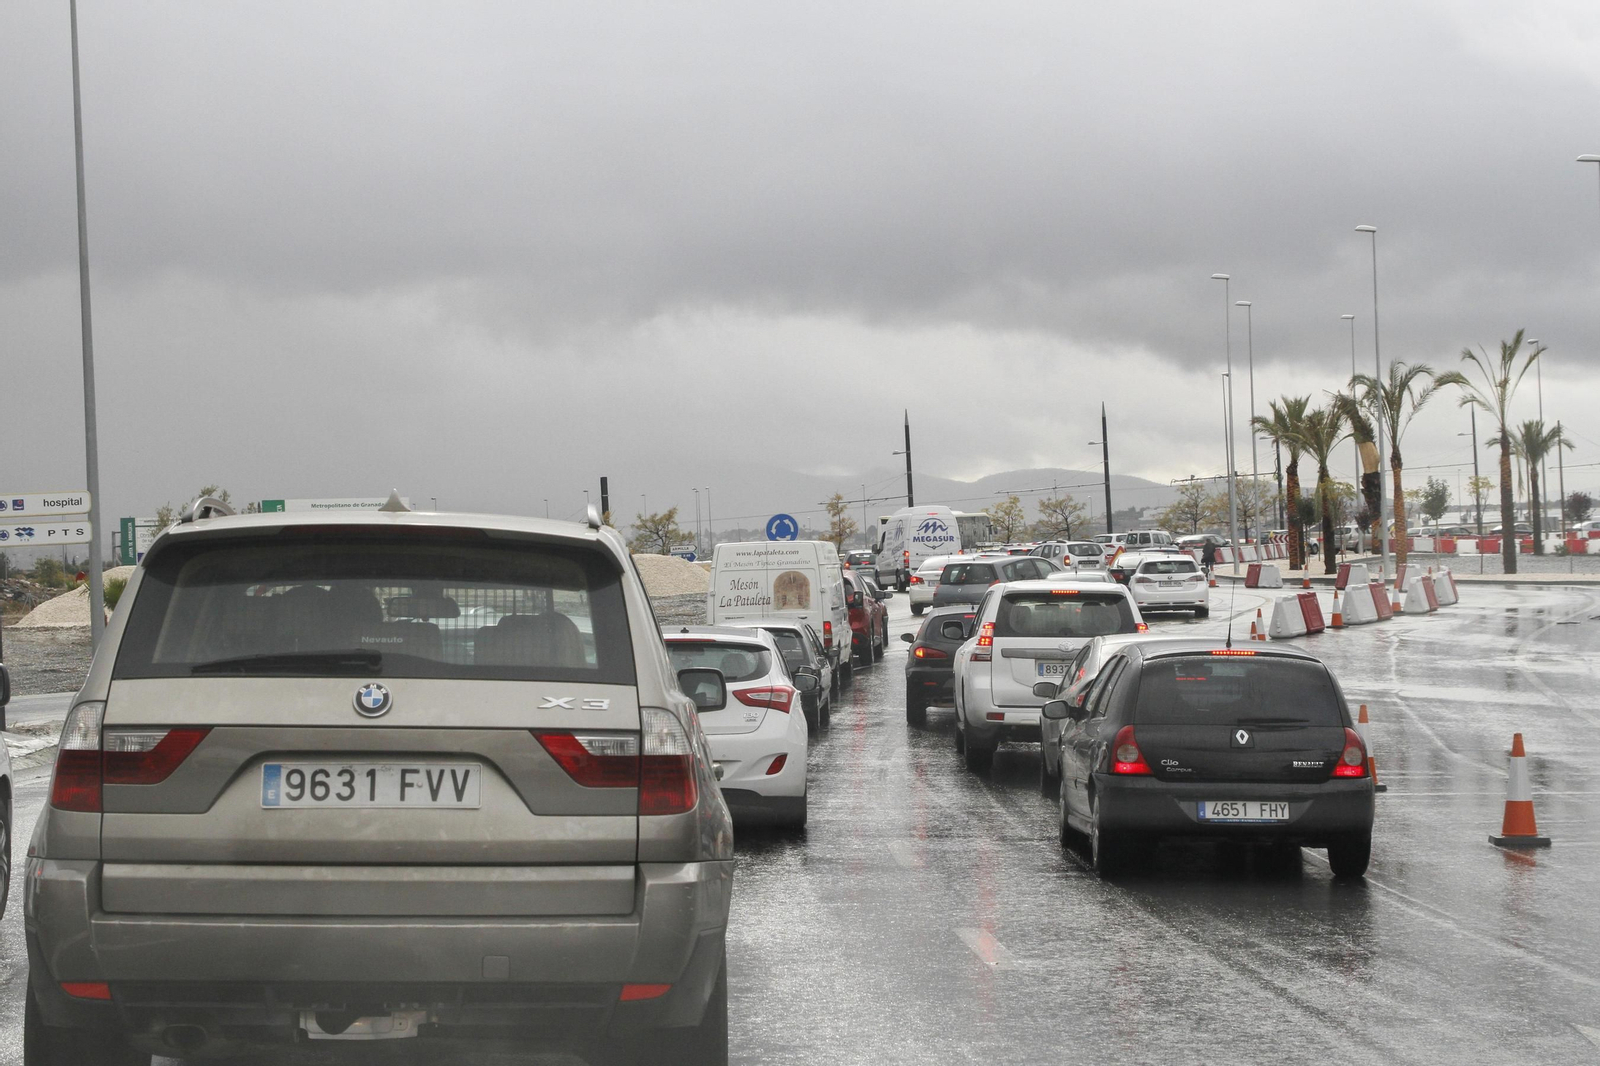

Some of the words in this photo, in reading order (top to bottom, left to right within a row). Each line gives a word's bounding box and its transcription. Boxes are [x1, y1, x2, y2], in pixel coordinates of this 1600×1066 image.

[43, 498, 82, 508] hospital
[913, 535, 955, 543] MEGASUR
[736, 549, 799, 557] www.lapataleta.com
[776, 558, 811, 567] Granadino
[730, 577, 759, 591] Mesón
[719, 595, 732, 607] La
[733, 592, 771, 607] Pataleta
[537, 696, 610, 711] X3
[267, 790, 276, 799] E
[285, 768, 377, 802] 9631
[400, 768, 471, 802] FVV
[1211, 802, 1248, 817] 4651
[1260, 803, 1287, 818] FHY
